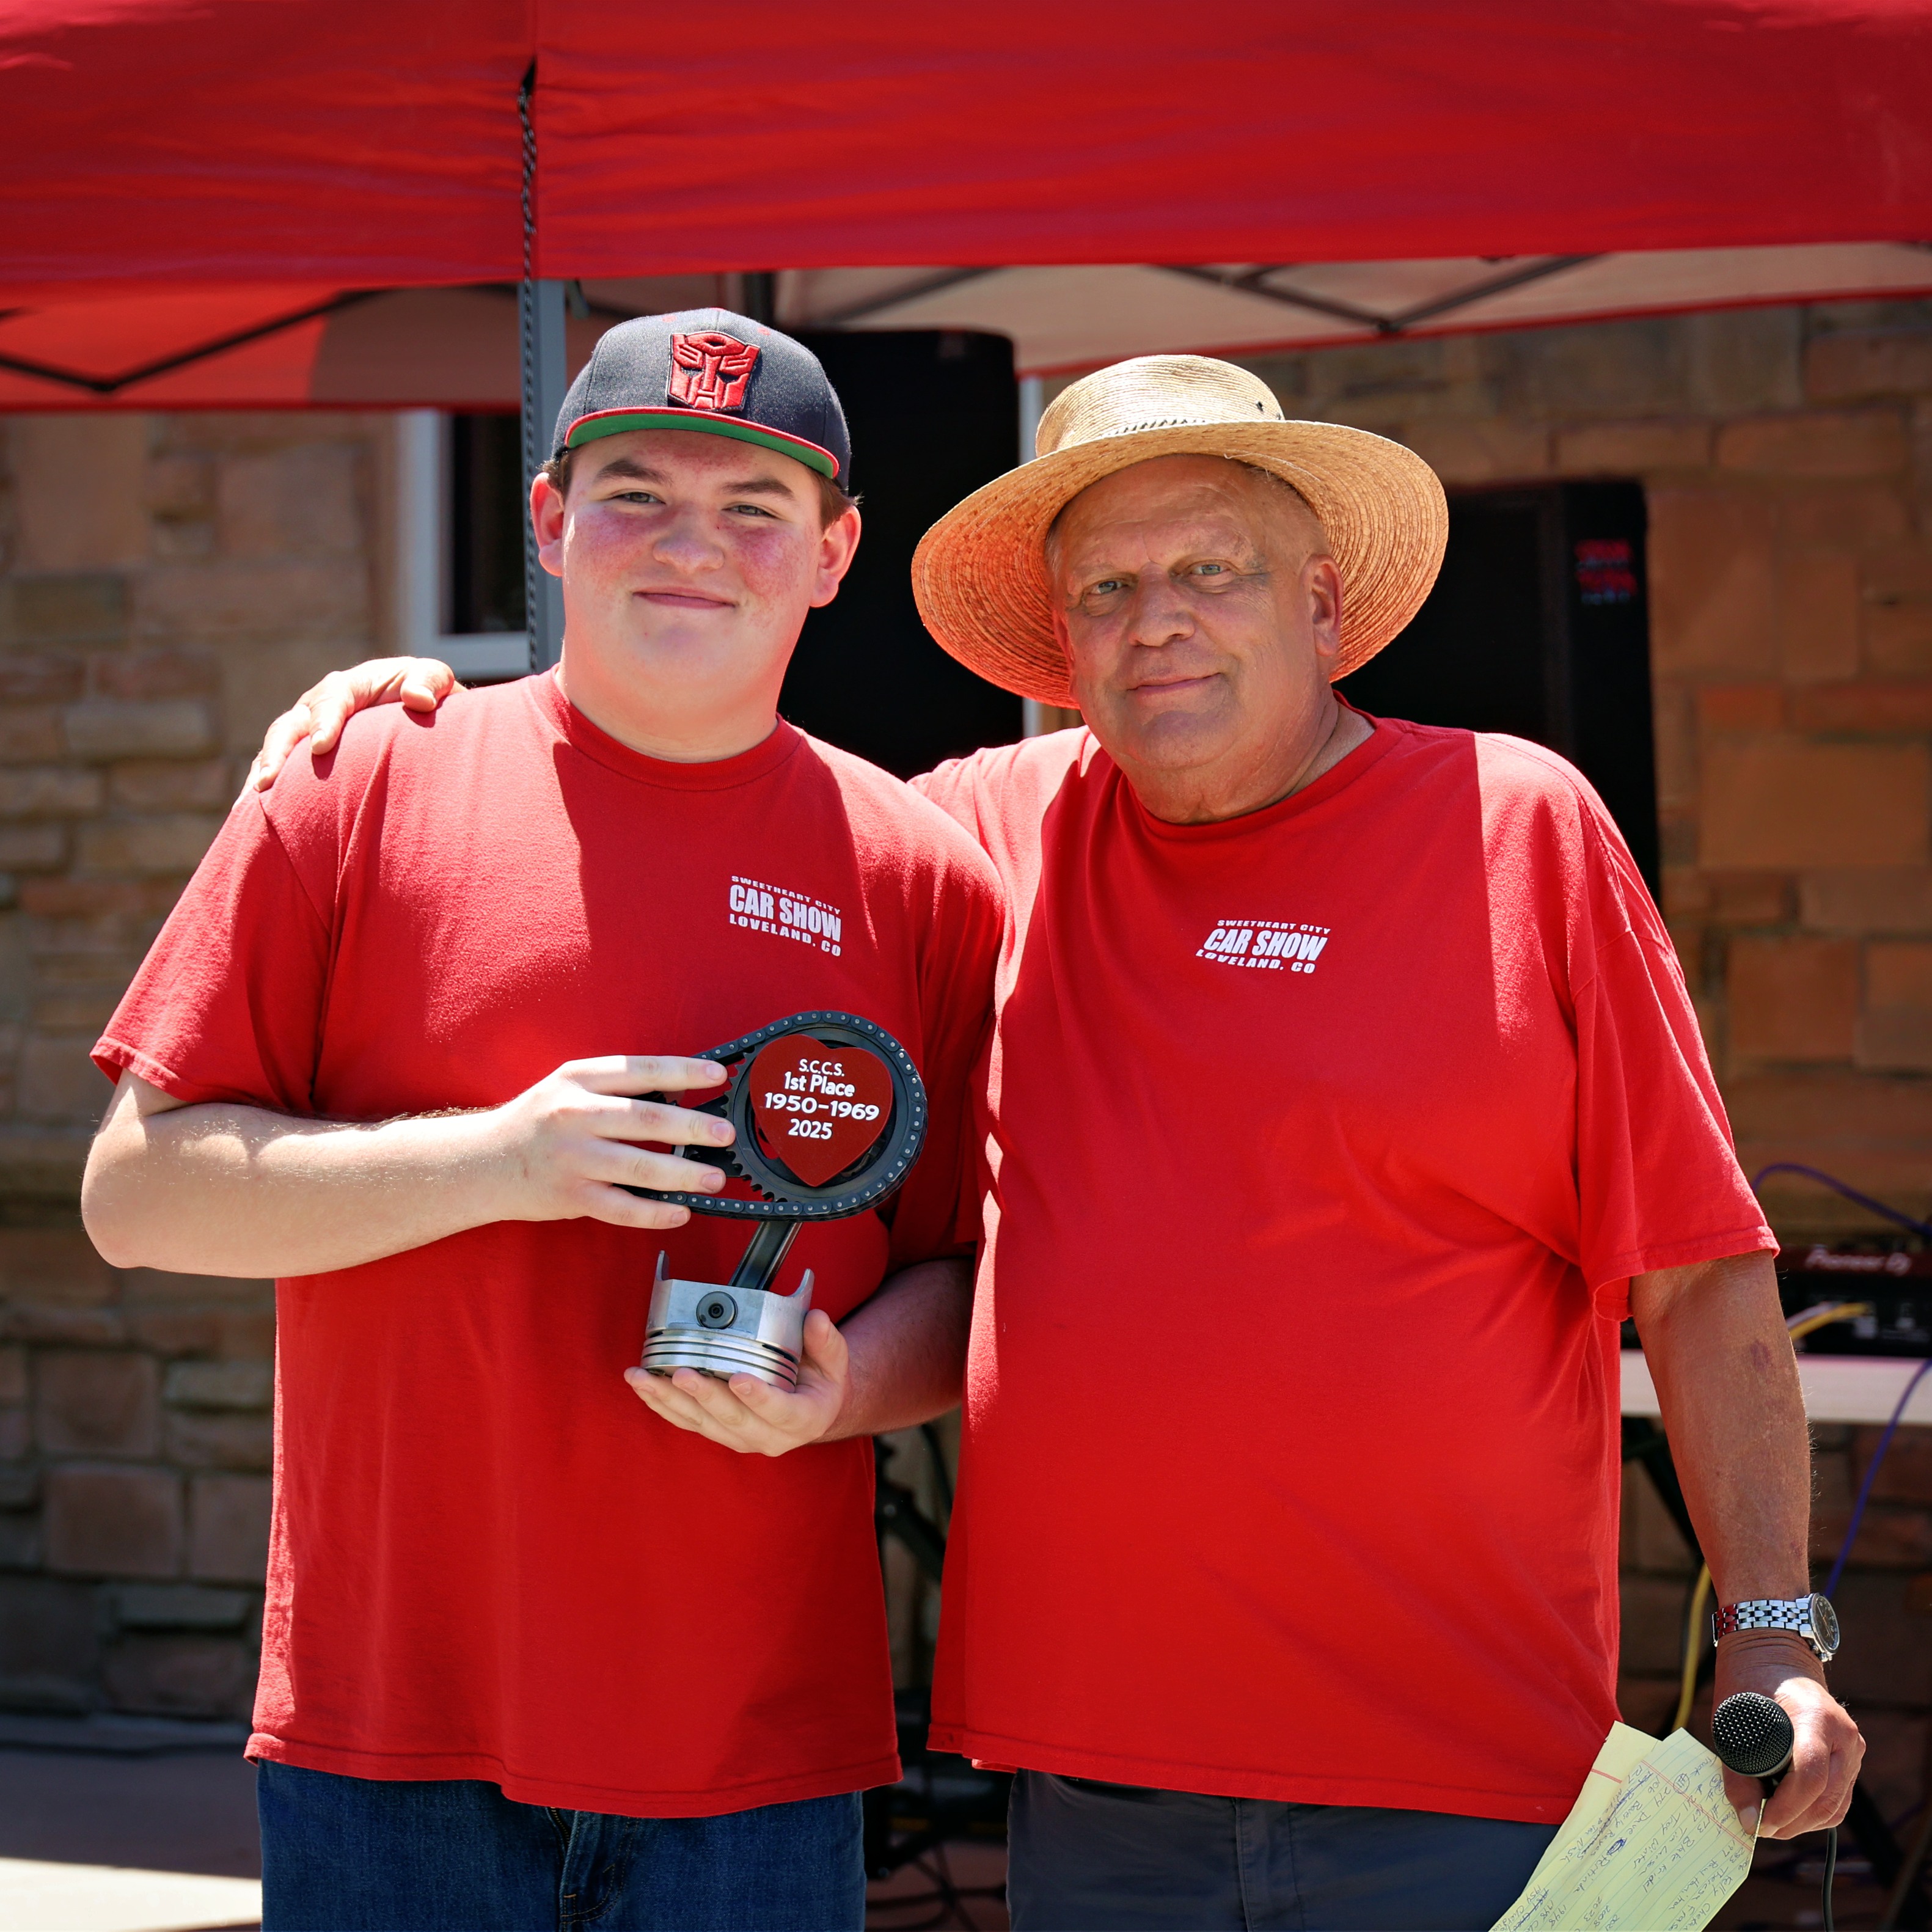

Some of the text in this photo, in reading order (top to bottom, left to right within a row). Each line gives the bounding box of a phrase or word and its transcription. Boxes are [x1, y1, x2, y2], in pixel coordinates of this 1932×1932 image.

[731, 876, 841, 915] SWEETHEART CITY
[730, 884, 841, 942] CAR SHOW
[1217, 920, 1331, 935] SWEETHEART CITY
[821, 940, 841, 957] CO
[1203, 928, 1328, 961] CAR SHOW
[1195, 949, 1315, 973] LOVELAND, CO
[799, 1058, 844, 1077] S.C.C.S.
[785, 1071, 855, 1097] 1st Place
[764, 1092, 880, 1121] 1950-1969
[788, 1118, 833, 1140] 2025
